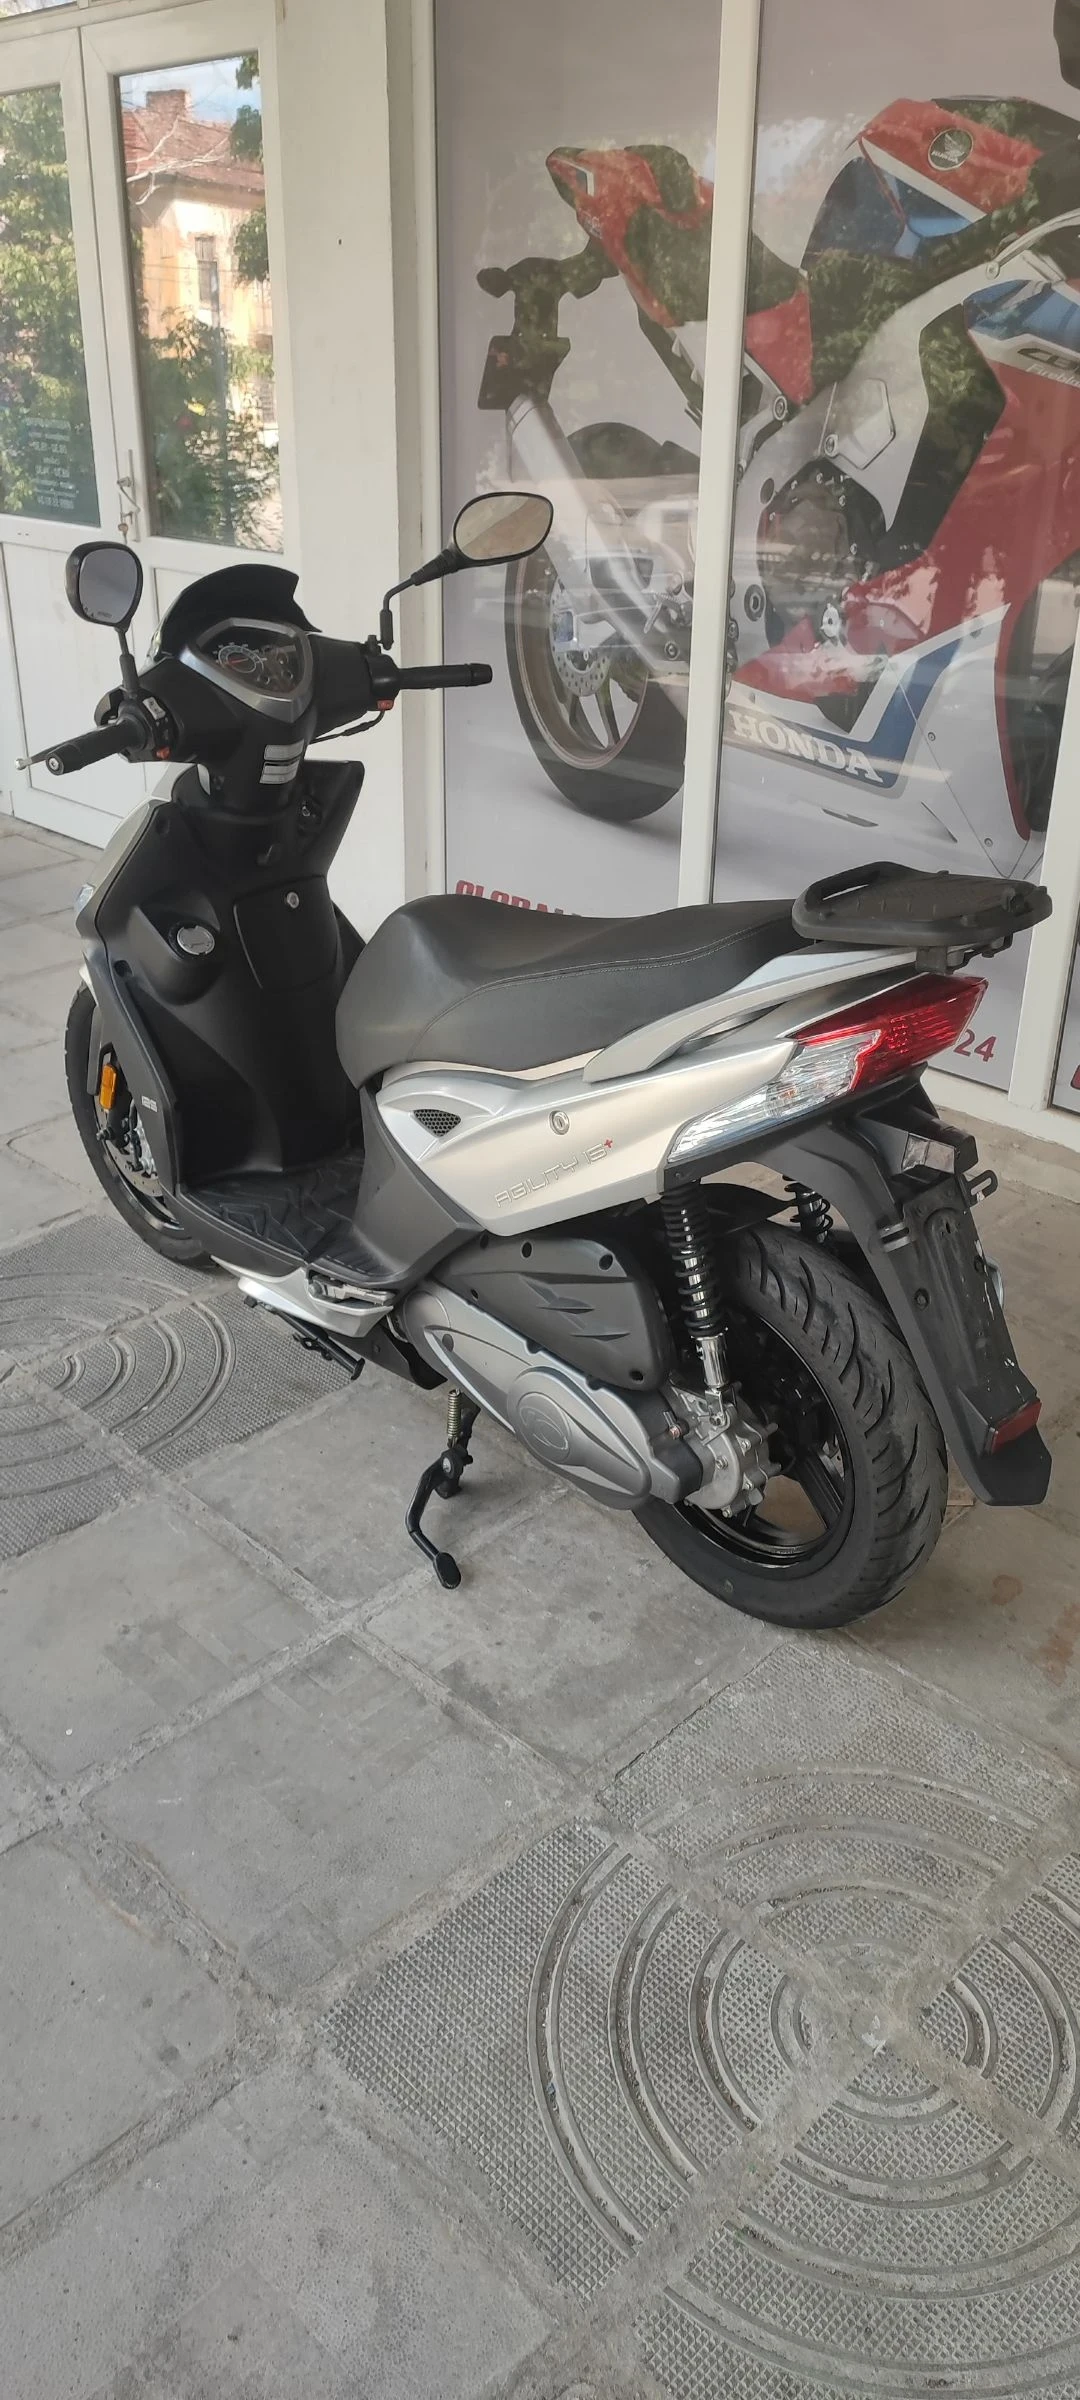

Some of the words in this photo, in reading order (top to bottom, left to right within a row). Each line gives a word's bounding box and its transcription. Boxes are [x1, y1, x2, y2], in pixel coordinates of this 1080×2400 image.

[729, 710, 883, 783] HONDA
[953, 1029, 997, 1062] 24
[495, 1156, 579, 1208] AGILITY
